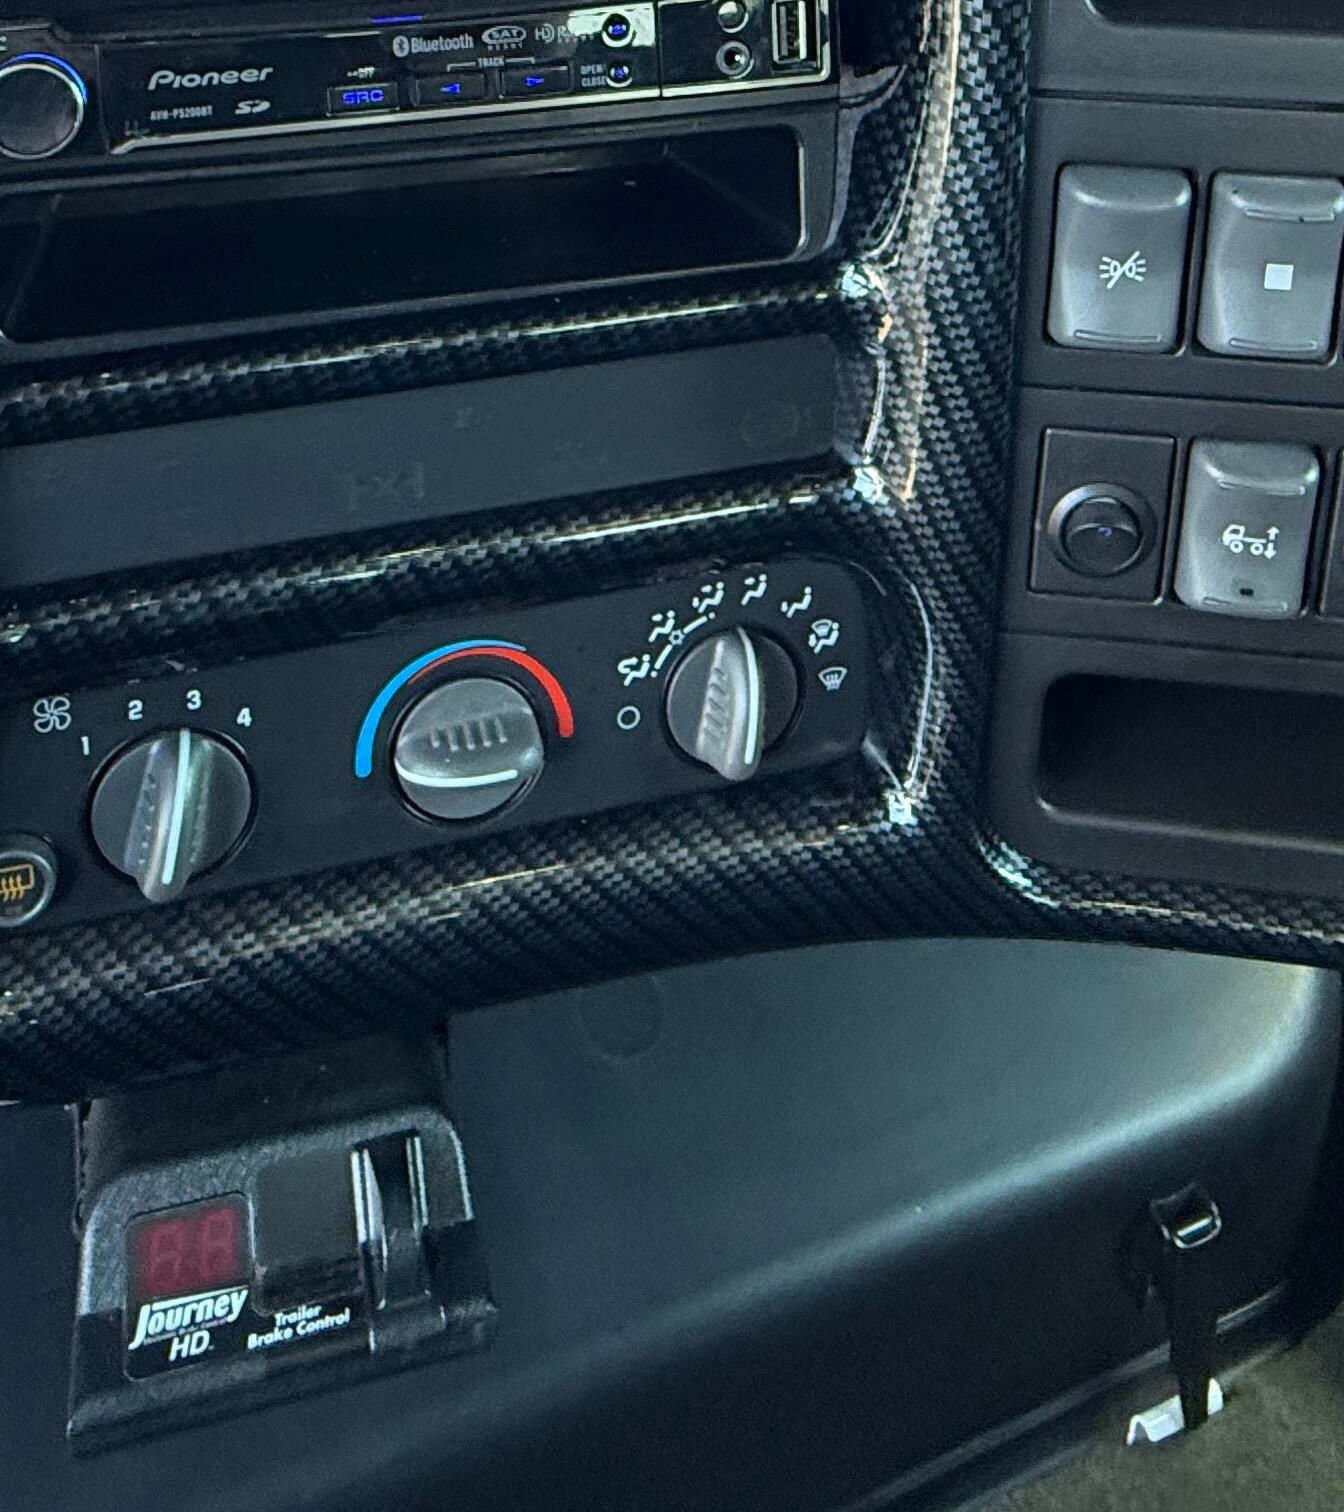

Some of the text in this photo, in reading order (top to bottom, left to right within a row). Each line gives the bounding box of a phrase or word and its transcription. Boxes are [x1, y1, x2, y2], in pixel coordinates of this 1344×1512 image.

[410, 33, 475, 54] Bluetooth
[147, 66, 274, 91] Pioneer
[342, 88, 385, 105] SRC
[80, 690, 253, 756] 1 2 3 4
[127, 1287, 249, 1351] Journey
[246, 1325, 294, 1351] Brake
[295, 1306, 351, 1336] Control
[273, 1303, 323, 1328] Trailer
[168, 1329, 211, 1362] HD
